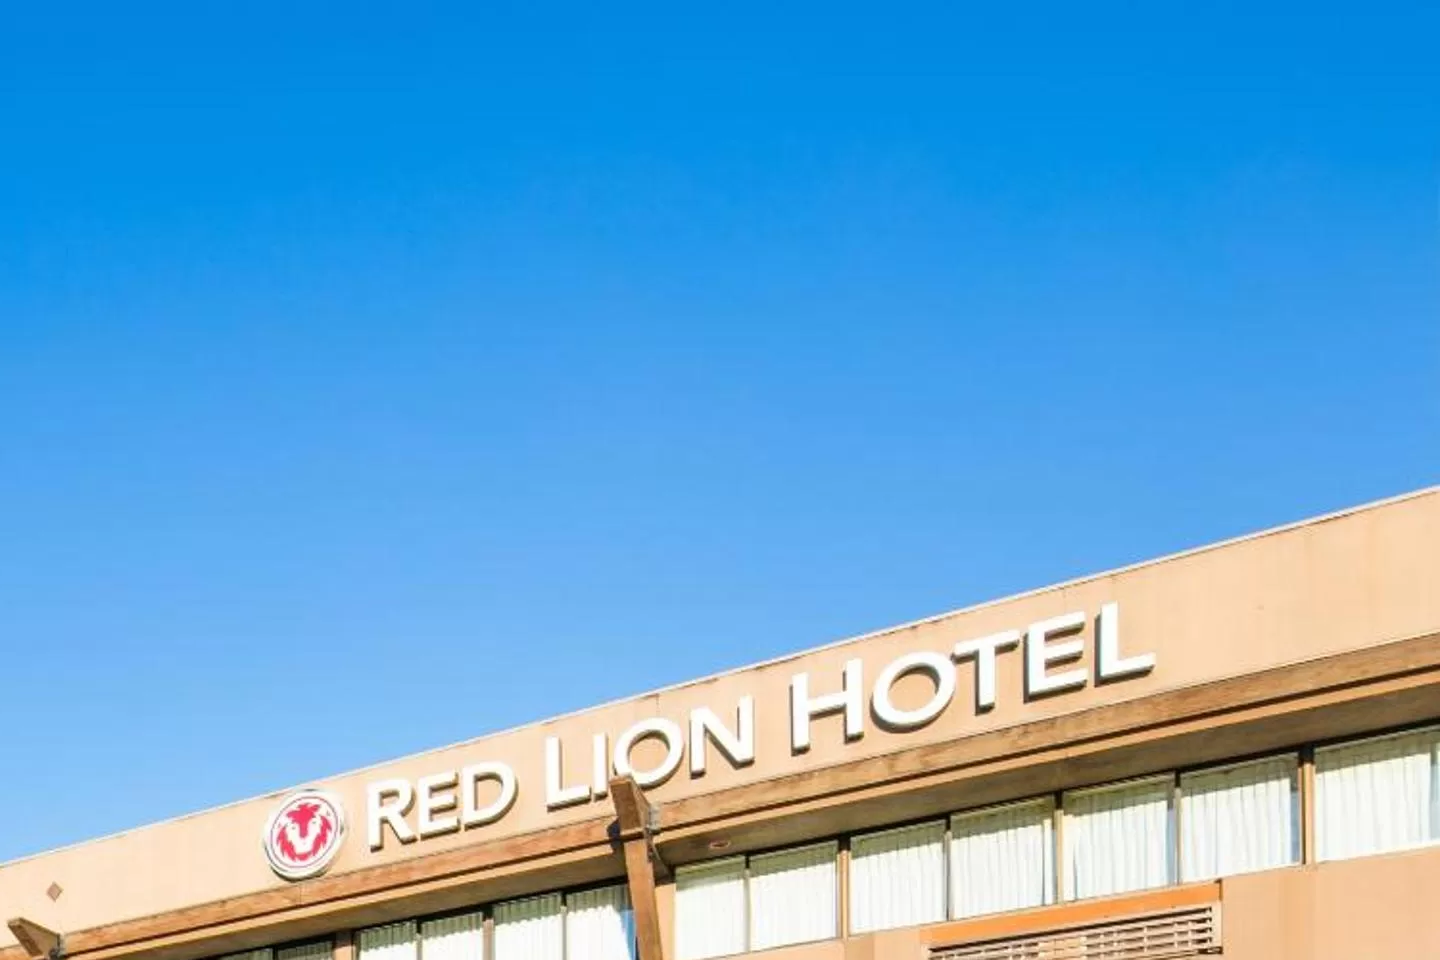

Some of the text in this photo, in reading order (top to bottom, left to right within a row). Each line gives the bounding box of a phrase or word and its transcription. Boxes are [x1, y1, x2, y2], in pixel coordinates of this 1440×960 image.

[365, 602, 1156, 851] RED LION HOTEL
